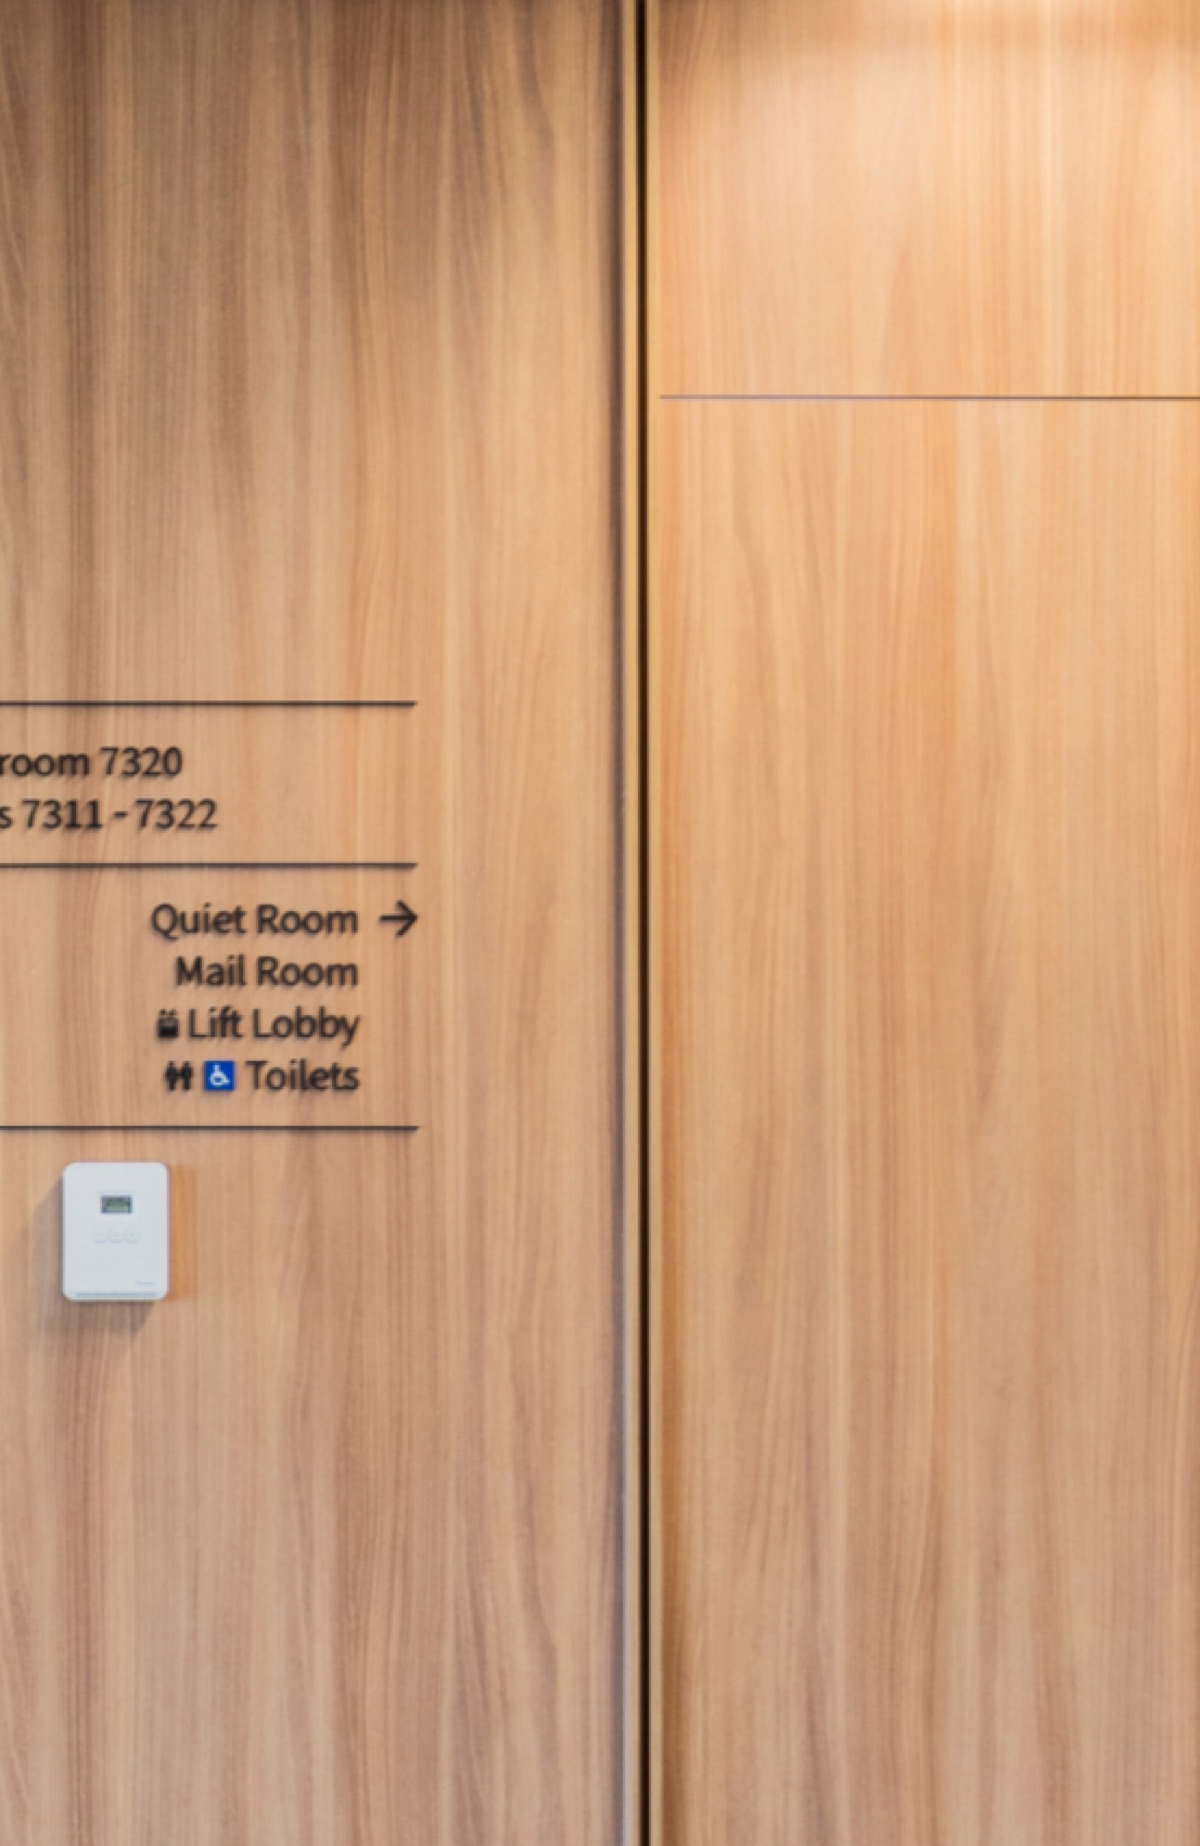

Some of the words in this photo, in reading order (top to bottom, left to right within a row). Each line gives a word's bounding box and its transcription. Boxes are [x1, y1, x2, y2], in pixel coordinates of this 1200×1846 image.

[101, 747, 183, 777] 7320
[21, 799, 103, 829] 7311
[136, 799, 218, 829] 7322
[151, 903, 246, 940] Quiet
[258, 905, 358, 934] Room
[175, 955, 246, 986] Mail
[257, 957, 358, 986] Room
[188, 1007, 243, 1039] Lift
[253, 1007, 360, 1047] Lobby
[245, 1060, 359, 1091] Toilets
